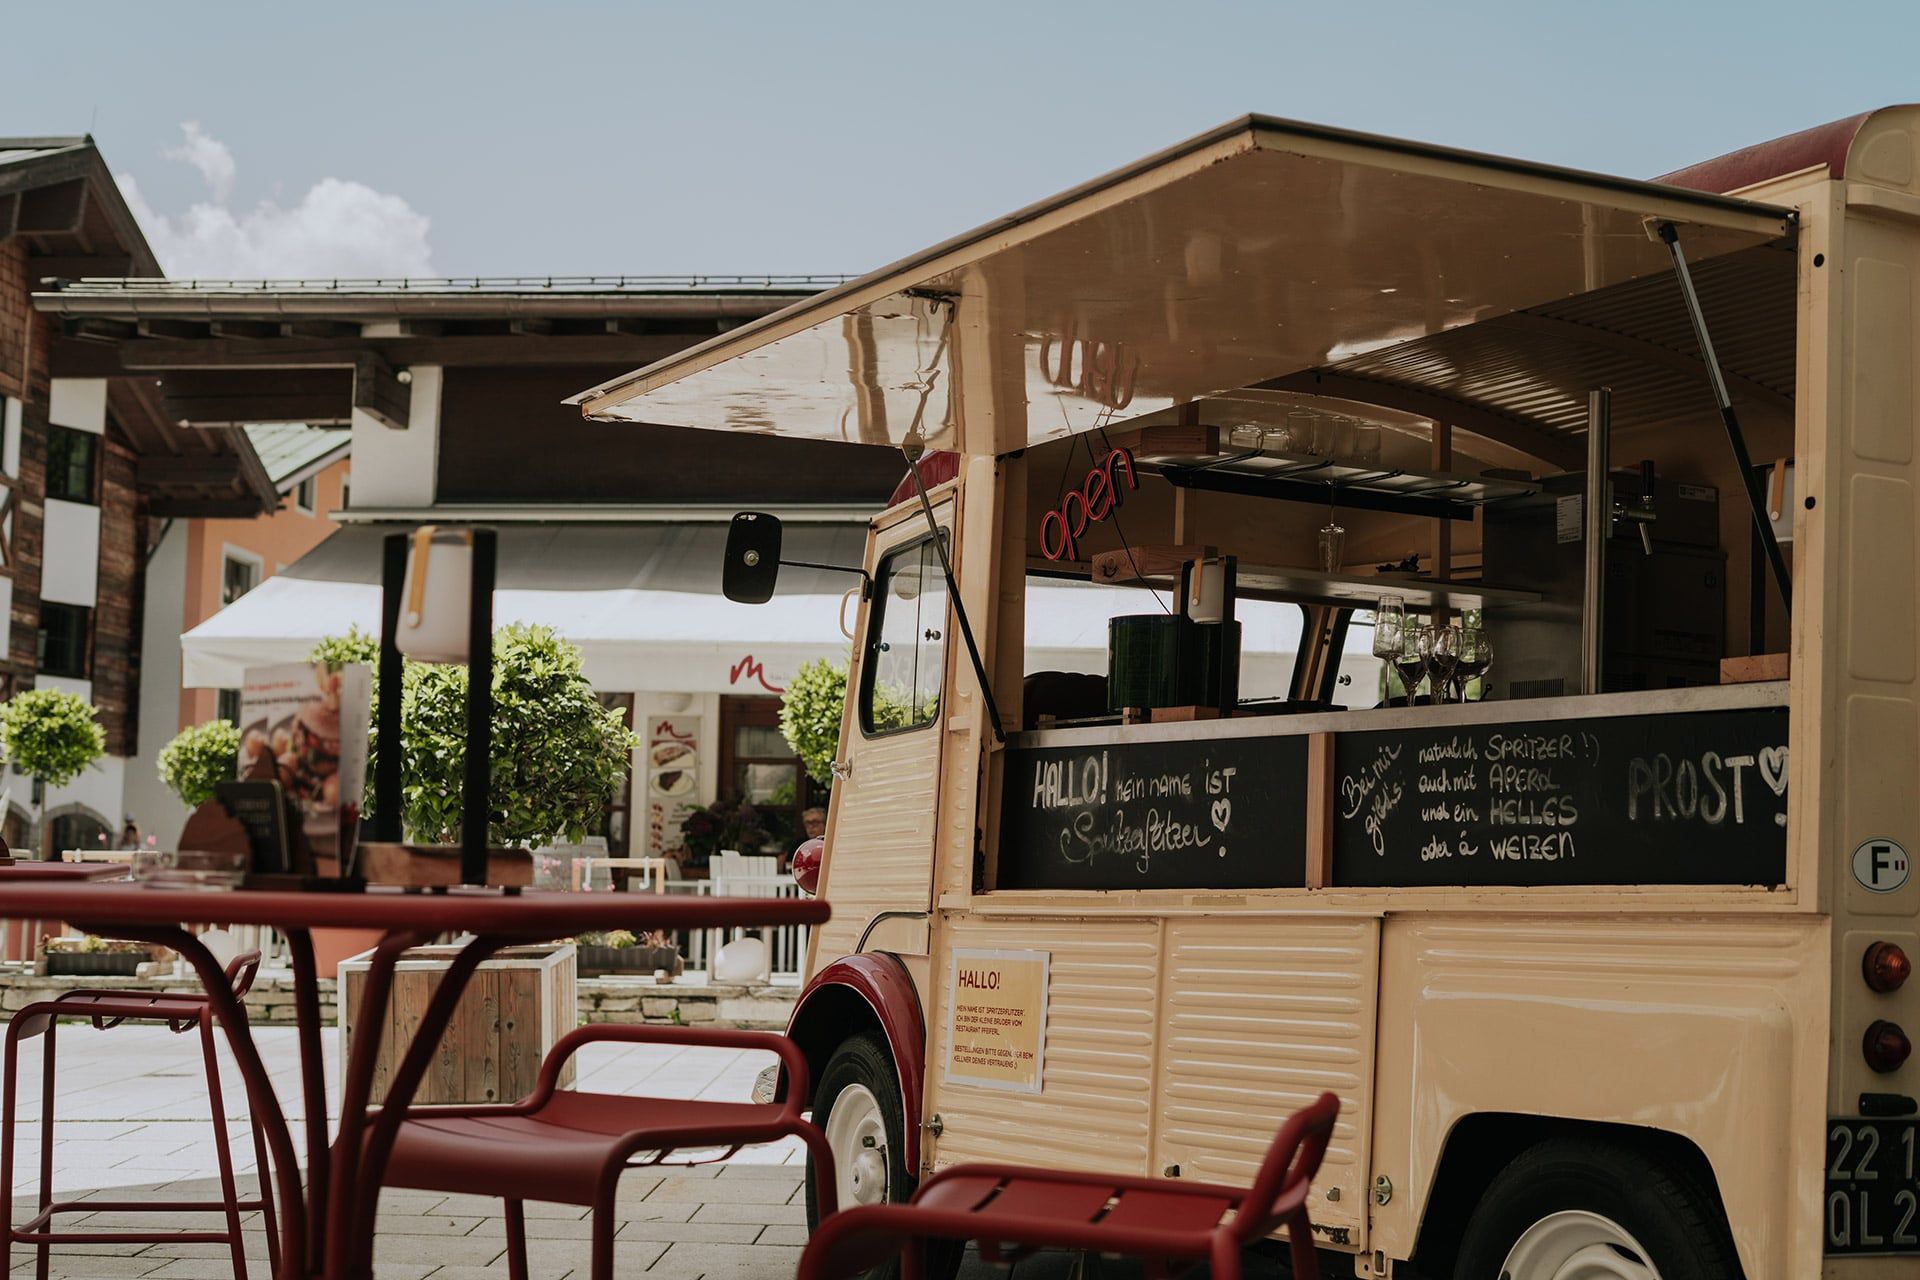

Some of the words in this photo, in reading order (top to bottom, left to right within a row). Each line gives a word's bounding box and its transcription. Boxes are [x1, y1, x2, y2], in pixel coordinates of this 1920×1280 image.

[1040, 448, 1140, 561] open
[1033, 750, 1108, 808] HALLO!
[1341, 766, 1376, 819] Bei
[1372, 744, 1402, 779] mir
[1418, 768, 1451, 793] auch
[1453, 764, 1477, 791] mit
[1421, 801, 1450, 822] und
[1453, 802, 1479, 822] ein
[1490, 795, 1578, 826] HELLES
[1421, 834, 1452, 861] oder
[958, 970, 1000, 990] HALLO!
[996, 1049, 1022, 1059] GEGENER
[1829, 1125, 1880, 1180] 22
